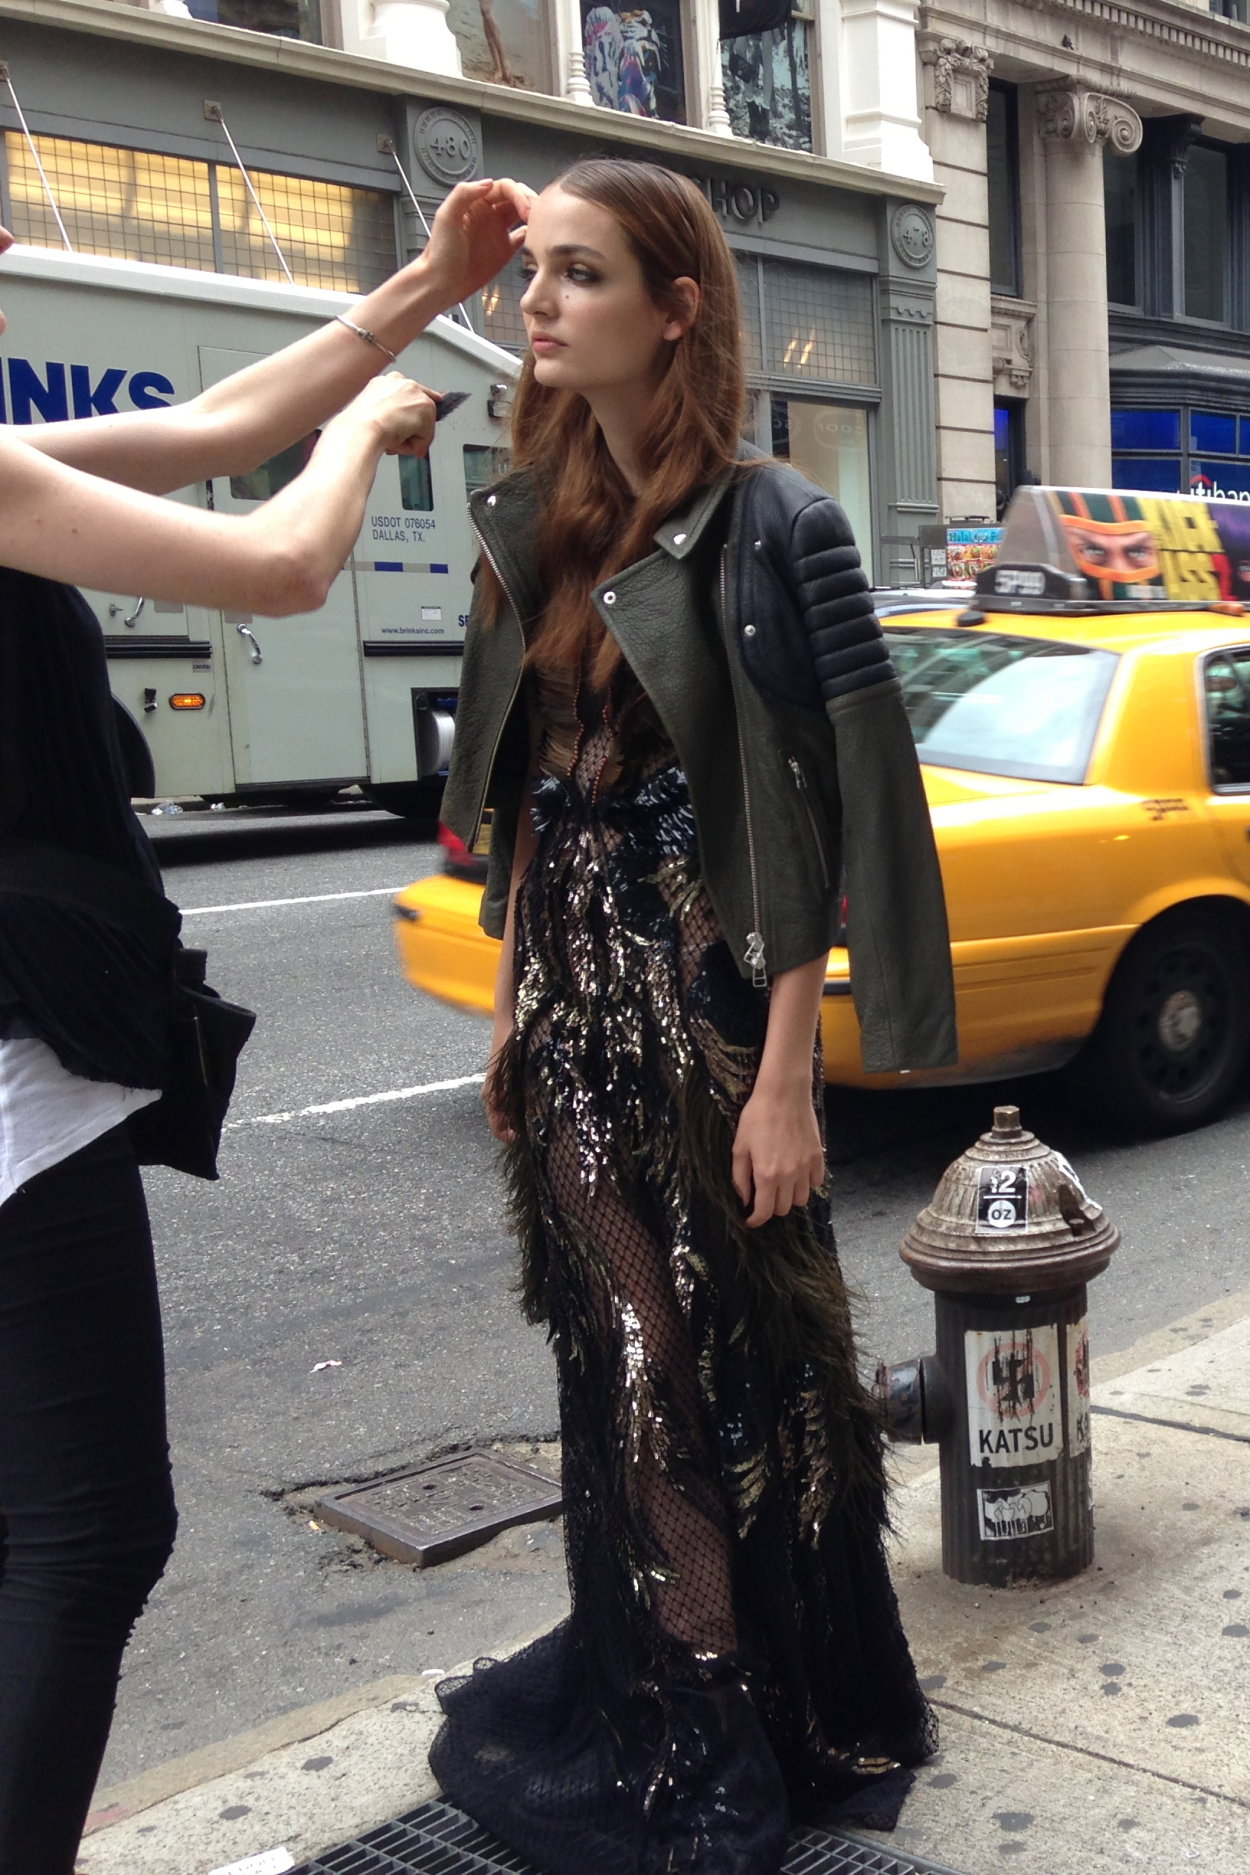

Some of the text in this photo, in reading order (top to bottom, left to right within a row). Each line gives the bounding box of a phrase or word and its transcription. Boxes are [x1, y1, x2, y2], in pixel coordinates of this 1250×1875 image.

[430, 137, 471, 160] 480
[695, 178, 780, 223] HOP
[903, 226, 929, 248] 478
[0, 357, 175, 425] NKS
[371, 516, 436, 529] USDOT 076054
[373, 529, 409, 543] DALLAS,
[381, 627, 445, 635] www.brinksinc.com
[979, 1422, 1054, 1454] KATSU
